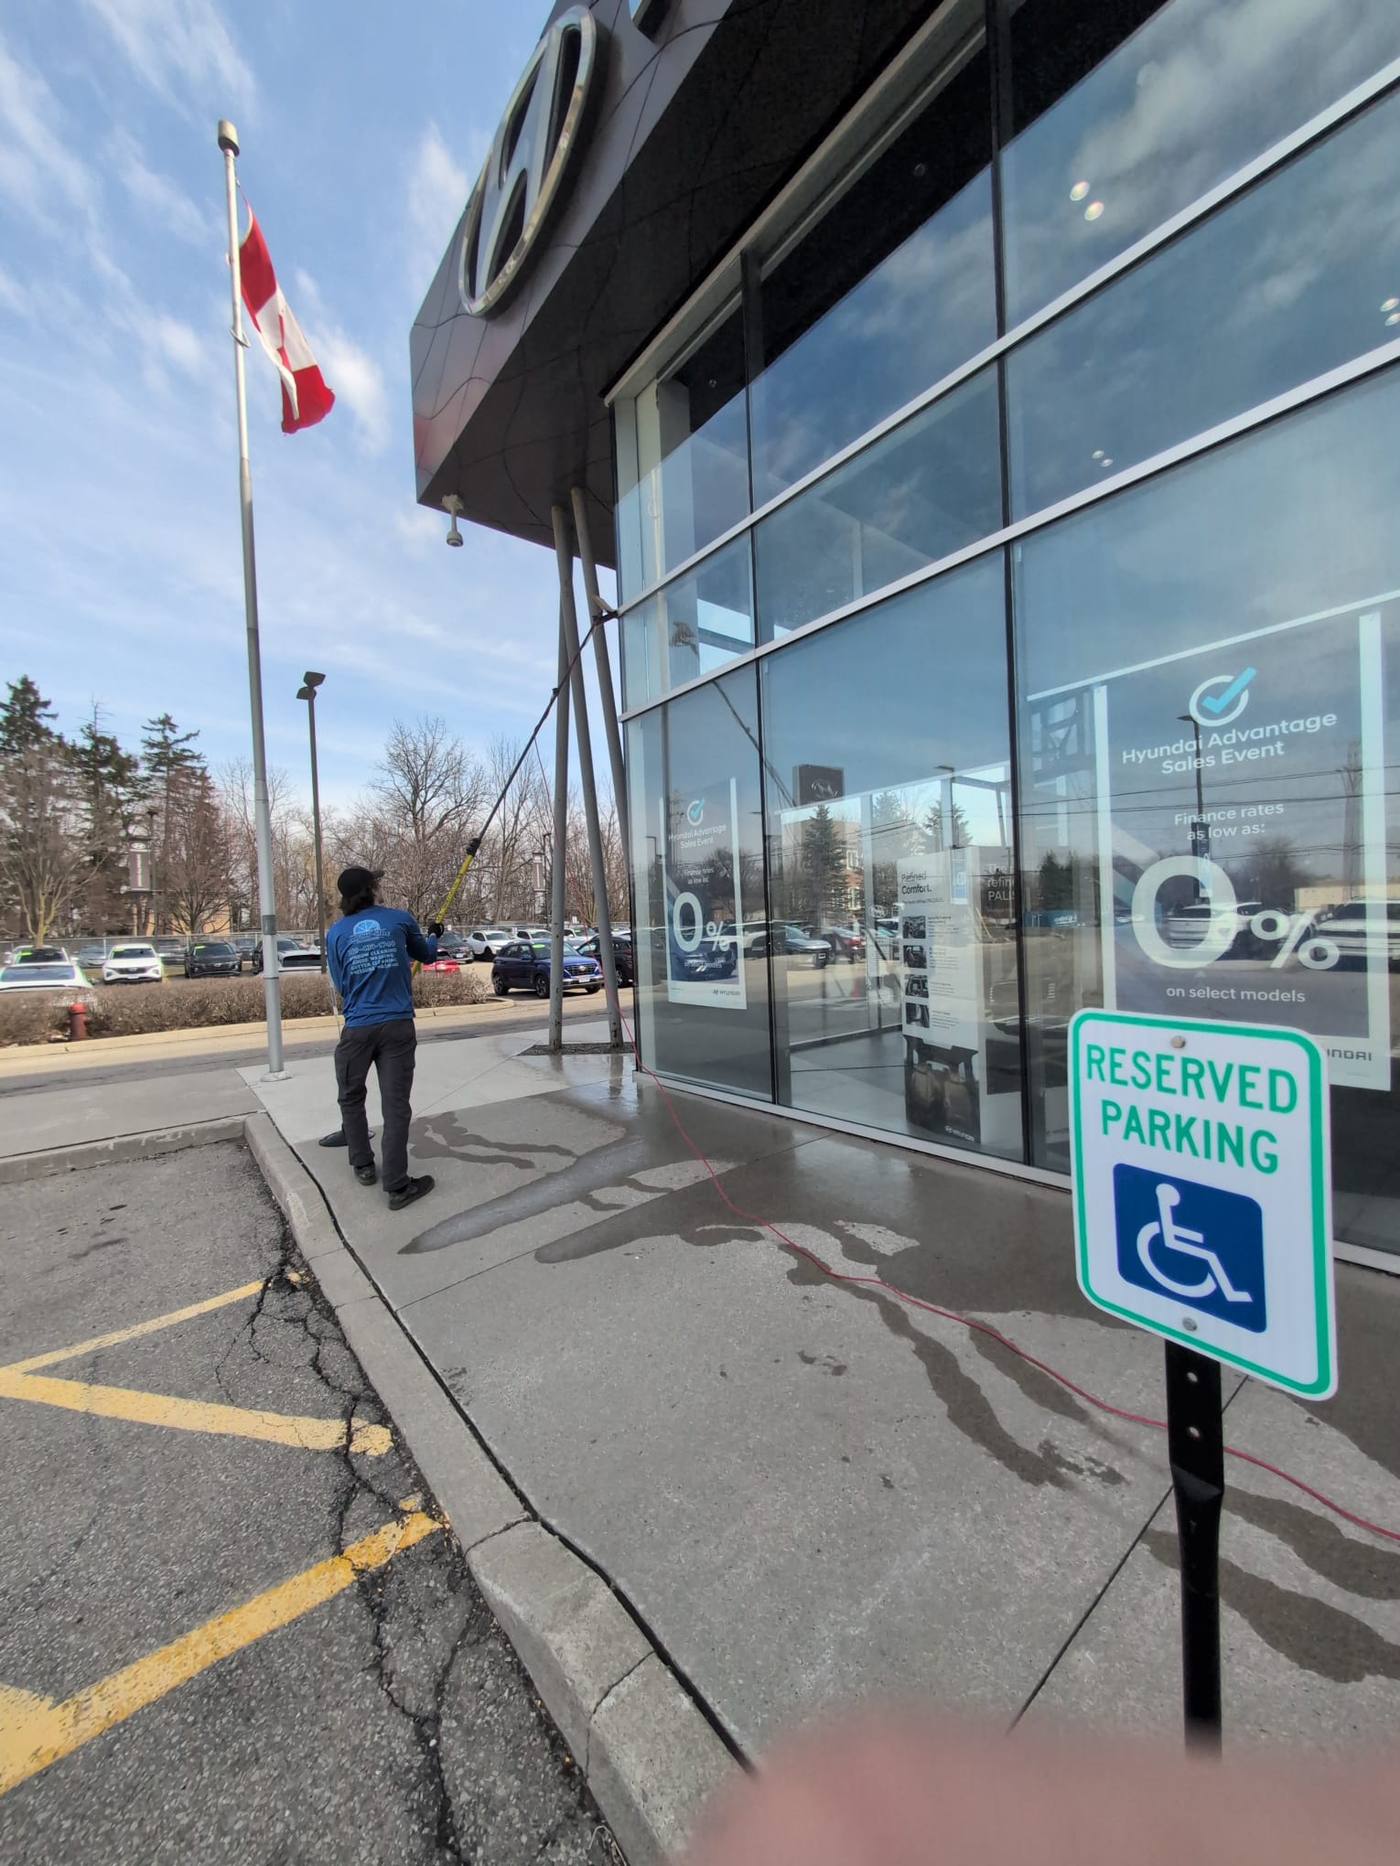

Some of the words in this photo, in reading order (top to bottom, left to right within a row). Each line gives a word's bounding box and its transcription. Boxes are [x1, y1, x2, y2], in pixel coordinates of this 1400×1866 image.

[1122, 736, 1203, 764] Hyundai
[1208, 713, 1338, 748] Advantage
[1161, 755, 1216, 774] Sales
[1221, 741, 1285, 765] Event
[1174, 809, 1237, 825] Finance
[1241, 803, 1285, 818] rates
[1187, 830, 1206, 841] as
[1208, 824, 1237, 838] low
[1242, 824, 1265, 836] as:
[1131, 855, 1340, 970] 0%
[1166, 987, 1185, 998] on
[1189, 985, 1237, 1000] select
[1241, 988, 1306, 1003] models
[1327, 1048, 1372, 1061] NDAI
[1086, 1044, 1298, 1115] RESERVED
[1101, 1099, 1279, 1175] PARKING
